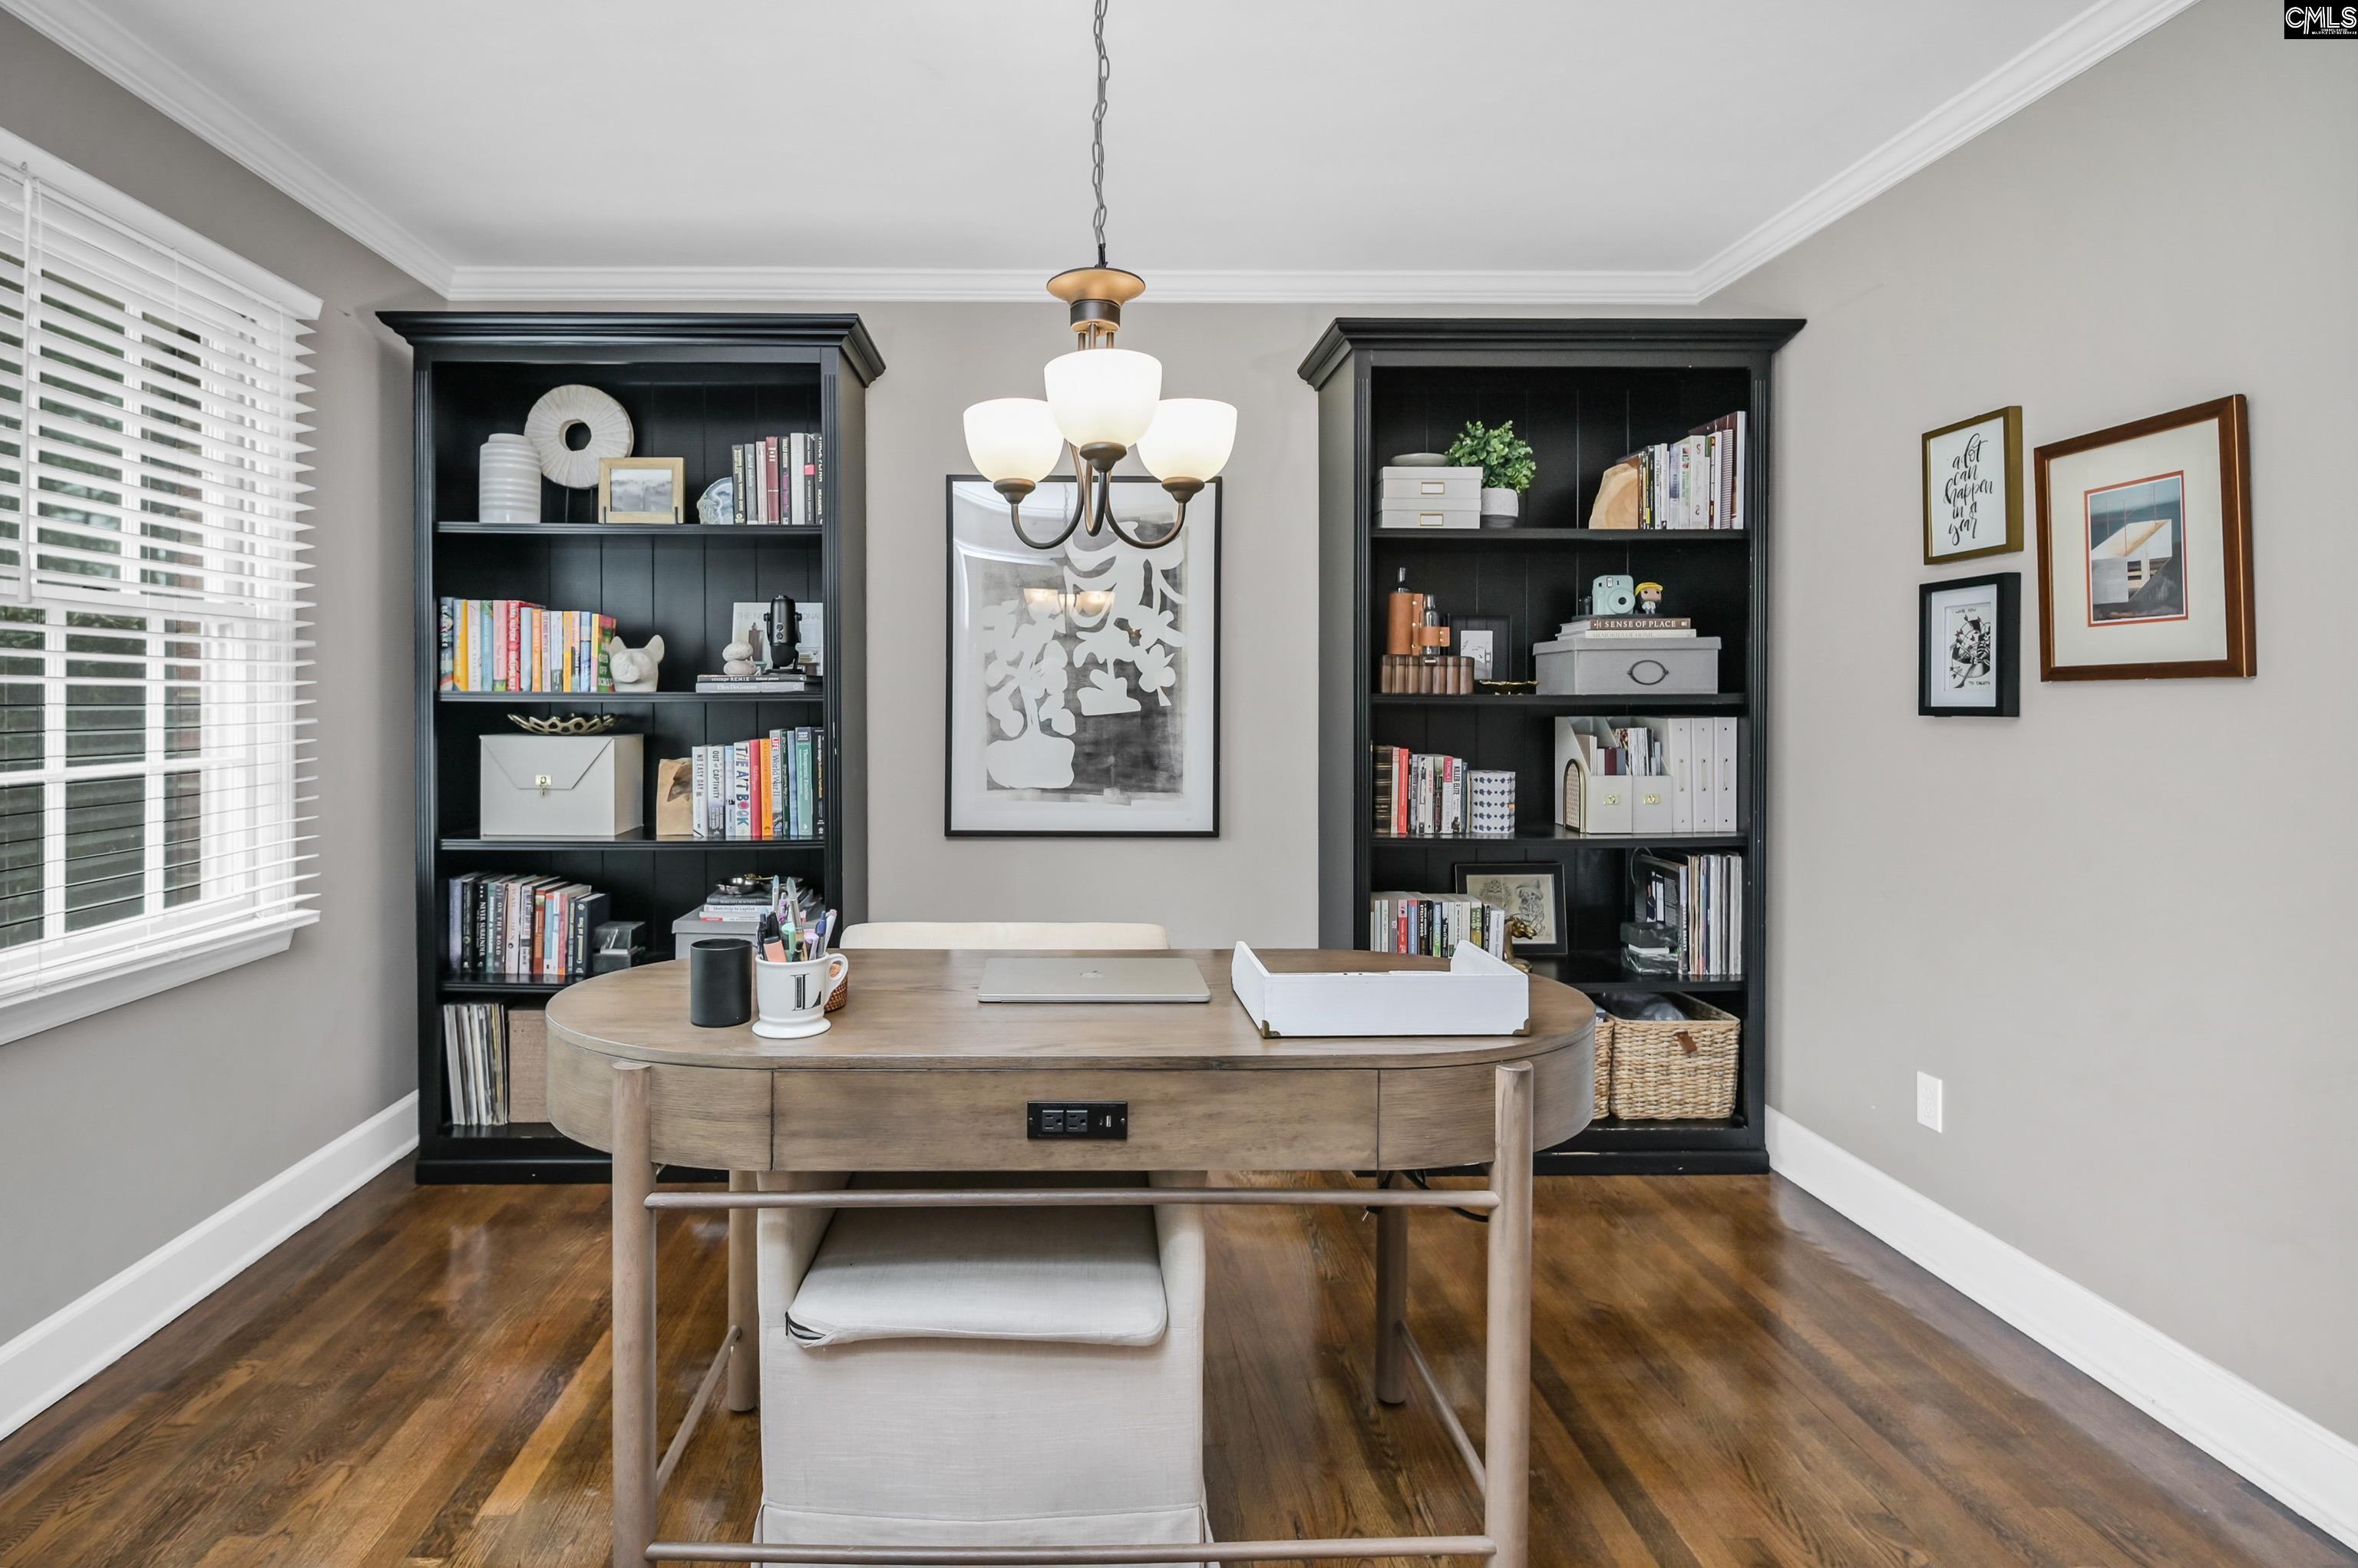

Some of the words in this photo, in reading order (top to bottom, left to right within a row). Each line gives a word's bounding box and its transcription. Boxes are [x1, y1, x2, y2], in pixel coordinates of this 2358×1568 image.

[1961, 432, 1989, 468] lot
[1953, 464, 1977, 486] can
[1944, 478, 1993, 507] happen
[1948, 512, 1977, 546] year
[735, 746, 749, 767] THE
[772, 777, 781, 791] War
[736, 794, 749, 826] BOOK
[497, 902, 503, 913] ON
[791, 972, 822, 1012] L
